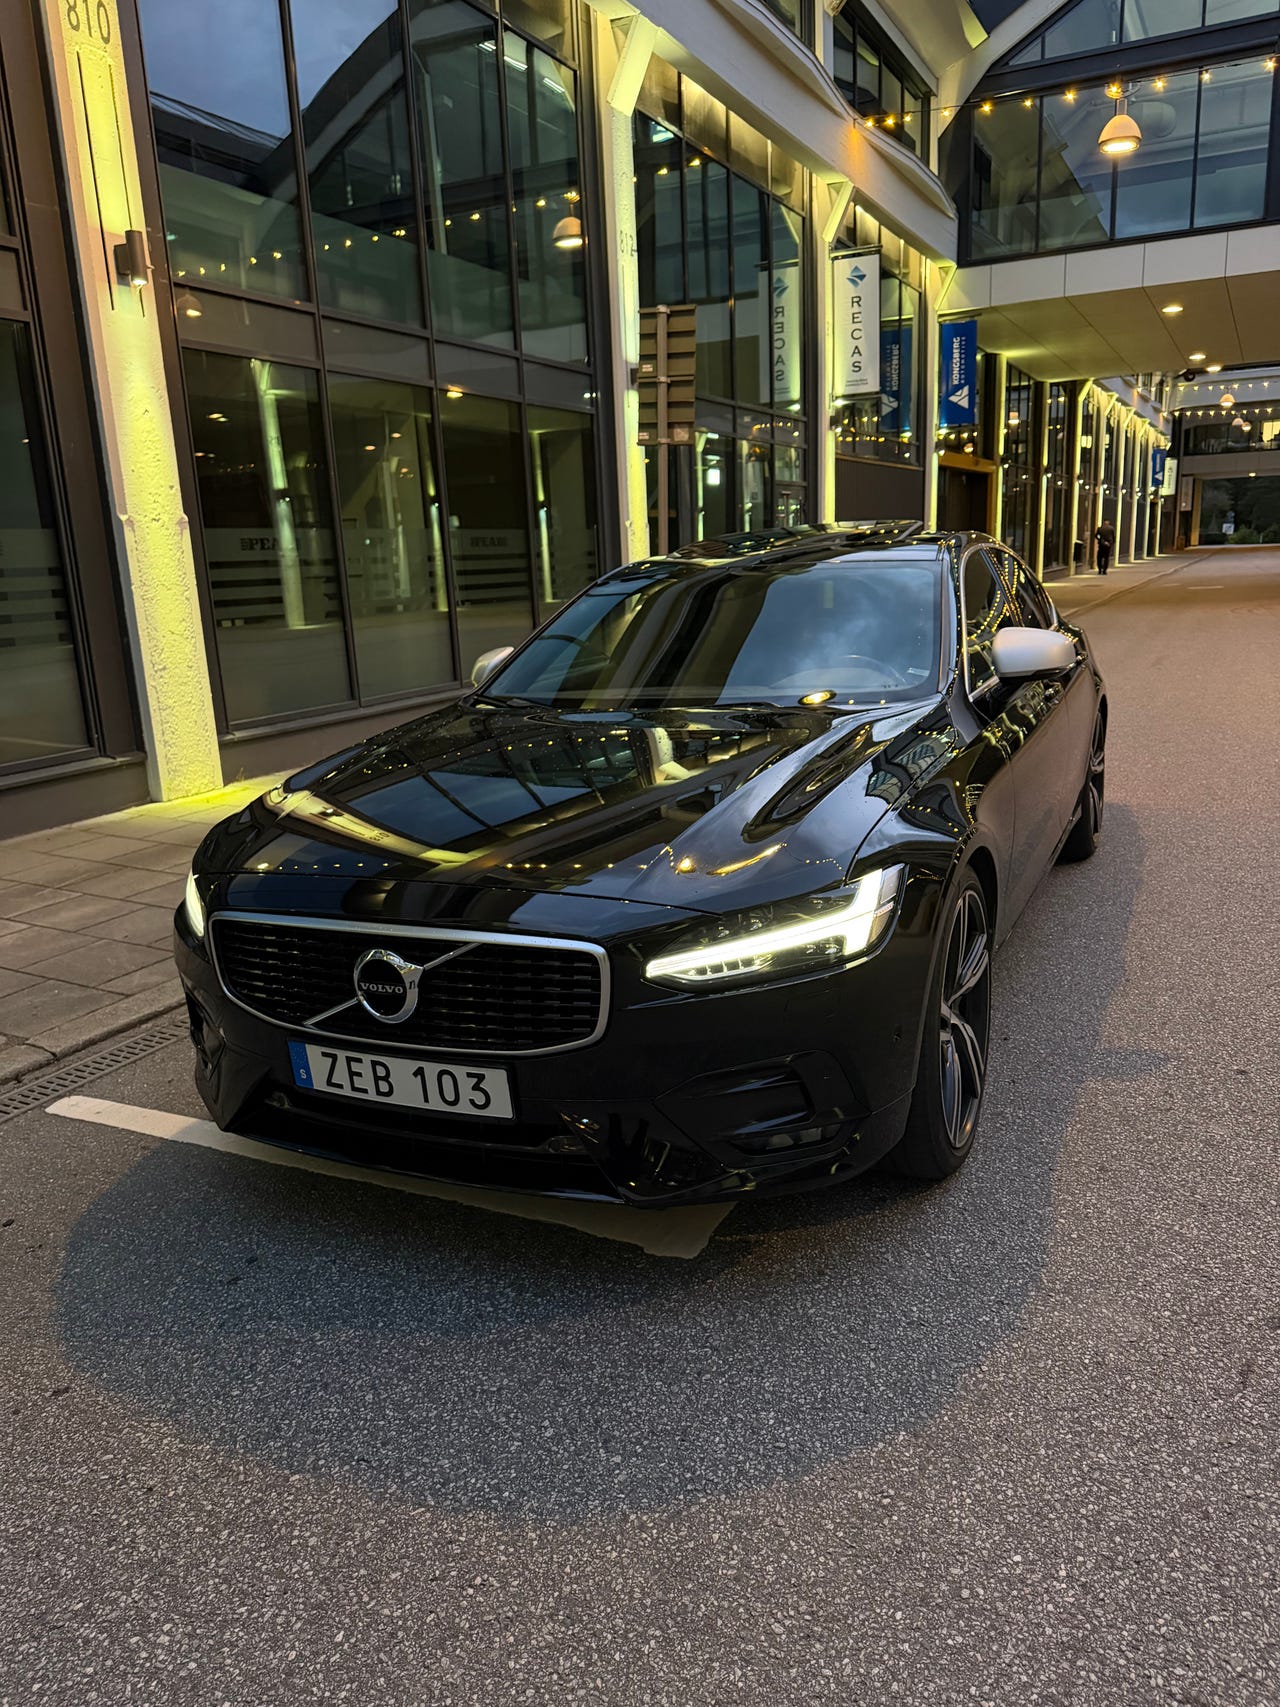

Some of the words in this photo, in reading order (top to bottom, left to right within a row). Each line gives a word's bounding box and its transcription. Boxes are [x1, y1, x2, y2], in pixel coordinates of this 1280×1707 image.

[66, 0, 110, 44] 810
[850, 295, 862, 373] RECAS
[952, 336, 960, 385] KONGSBERG
[360, 982, 403, 994] VOLVO
[300, 1069, 307, 1079] S
[321, 1051, 394, 1098] ZEB
[412, 1066, 491, 1110] 103
